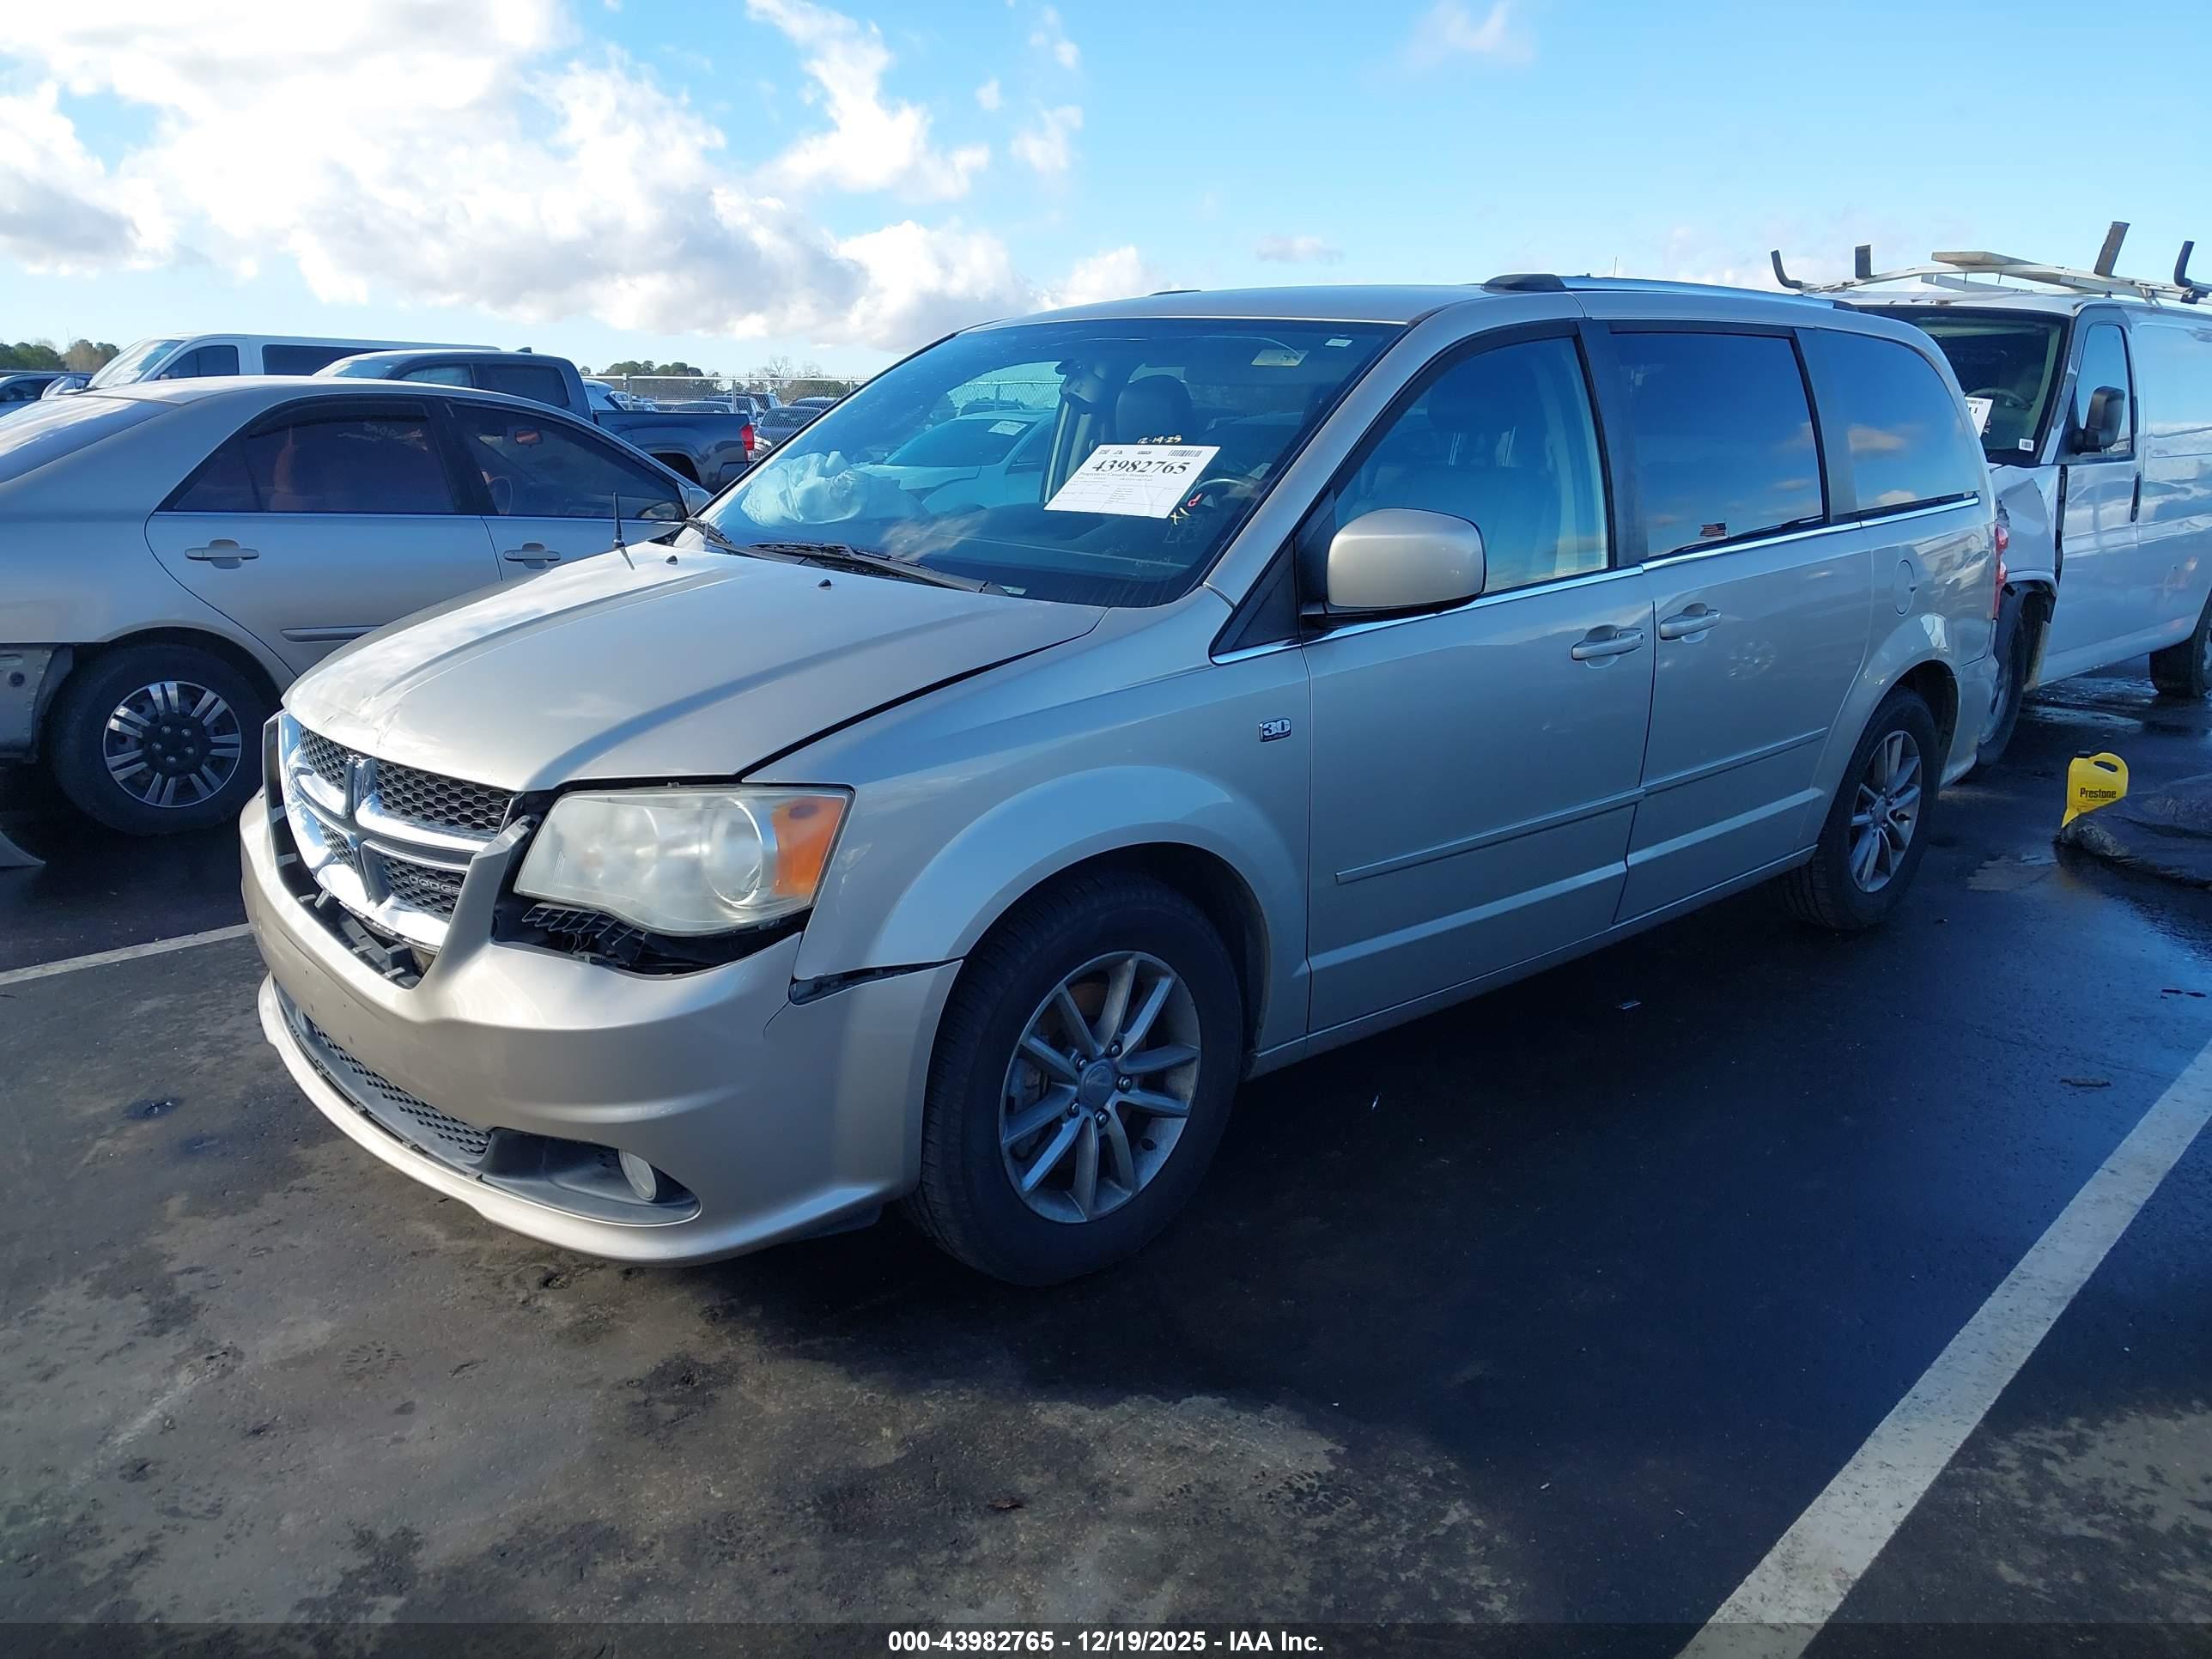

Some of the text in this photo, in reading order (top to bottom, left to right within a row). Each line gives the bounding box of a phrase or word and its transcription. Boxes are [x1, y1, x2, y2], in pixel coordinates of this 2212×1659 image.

[1092, 459, 1191, 475] 43982765
[2080, 787, 2117, 799] Prestone
[409, 875, 462, 895] DODGE
